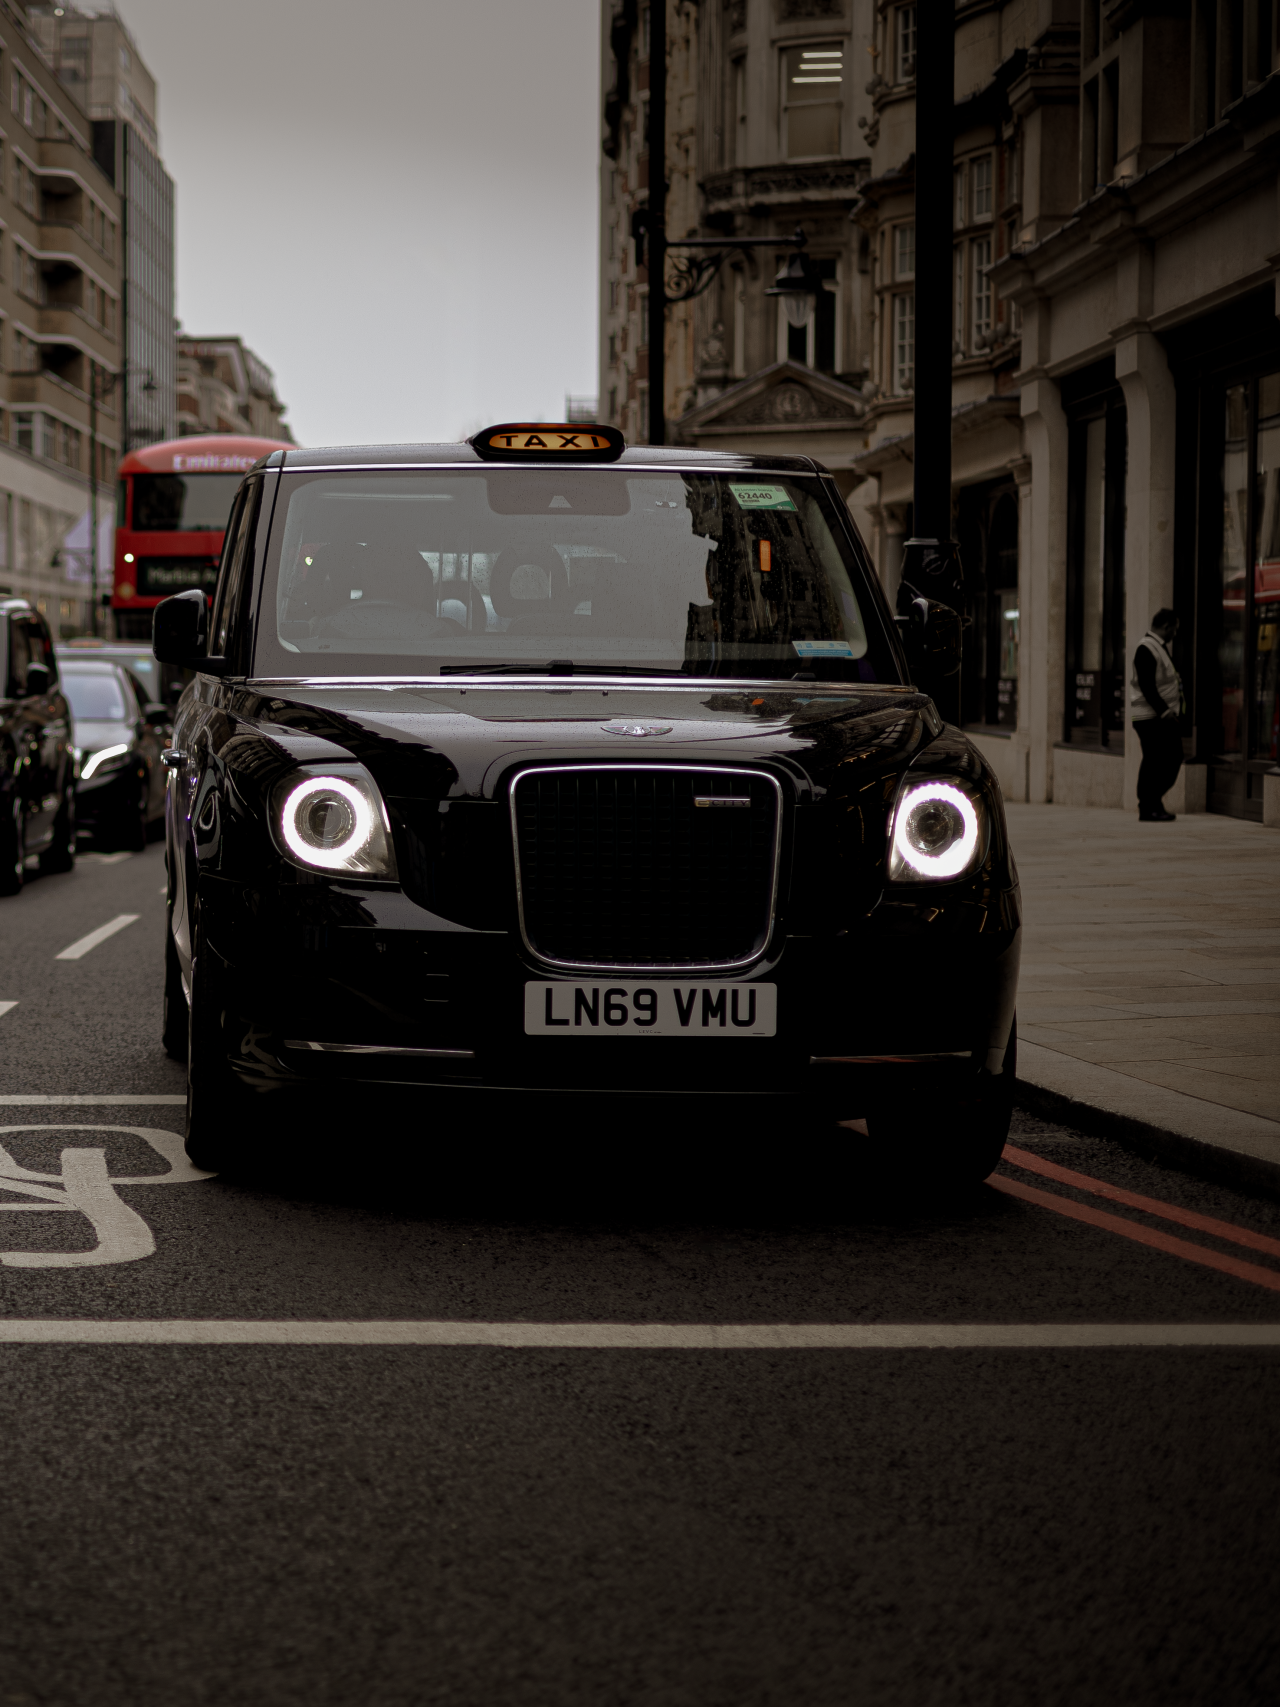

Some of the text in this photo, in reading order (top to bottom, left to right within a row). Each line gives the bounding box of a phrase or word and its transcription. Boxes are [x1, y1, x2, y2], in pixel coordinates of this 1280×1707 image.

[499, 434, 600, 448] TAXI
[738, 492, 773, 500] 62440
[545, 987, 756, 1027] LN69 VMU
